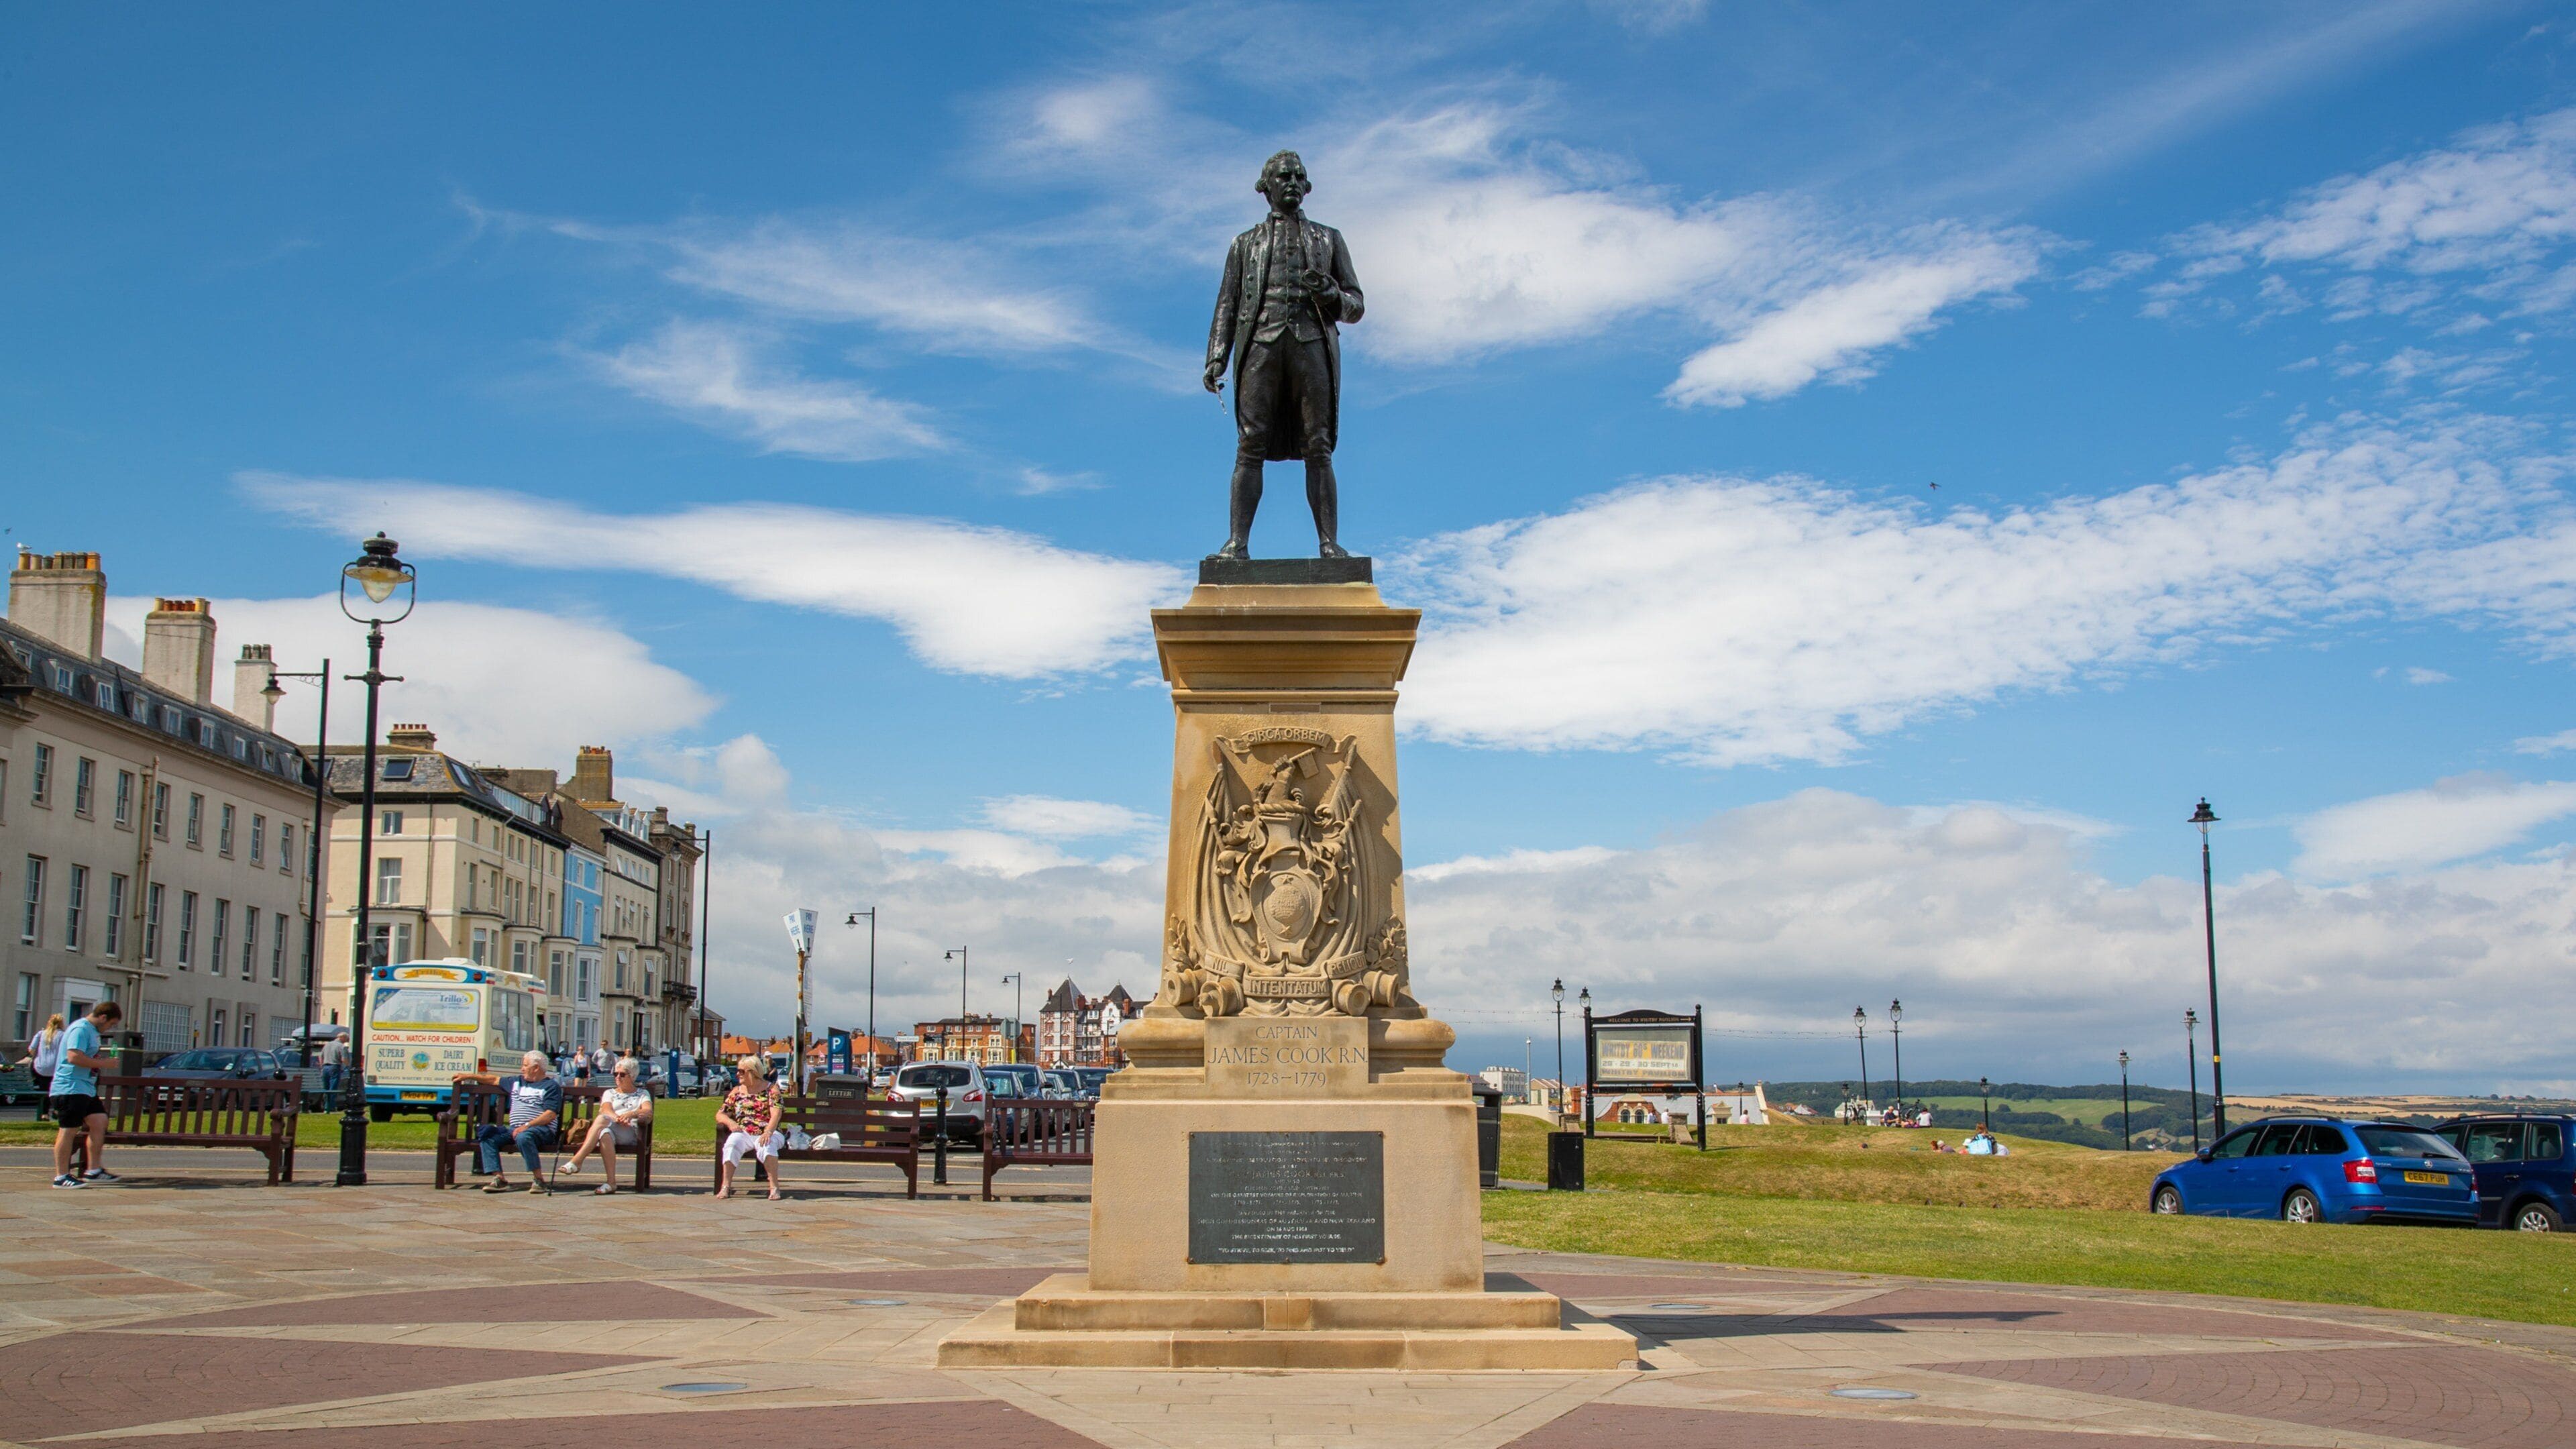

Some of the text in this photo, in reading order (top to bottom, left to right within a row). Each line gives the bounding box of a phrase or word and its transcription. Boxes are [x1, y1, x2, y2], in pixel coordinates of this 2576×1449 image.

[1246, 728, 1326, 743] CIRCA ORBEM
[804, 924, 814, 934] HERE
[1212, 959, 1229, 973] NIL
[1250, 980, 1327, 994] INTENTATUM
[439, 994, 468, 1003] Trillo's
[1255, 1026, 1318, 1039] CAPTAIN
[442, 1036, 471, 1044] CHILDREN
[833, 1037, 841, 1050] P
[378, 1048, 405, 1058] SUPERB
[443, 1050, 465, 1059] DAIRY
[1208, 1046, 1368, 1064] JAMES COOK R.N.
[1601, 1042, 1630, 1059] WHITBY
[1651, 1043, 1684, 1060] WEEKEND
[375, 1060, 407, 1072] QUALITY
[434, 1061, 472, 1072] ICE CREAM
[2408, 1173, 2446, 1183] CE67 PUH
